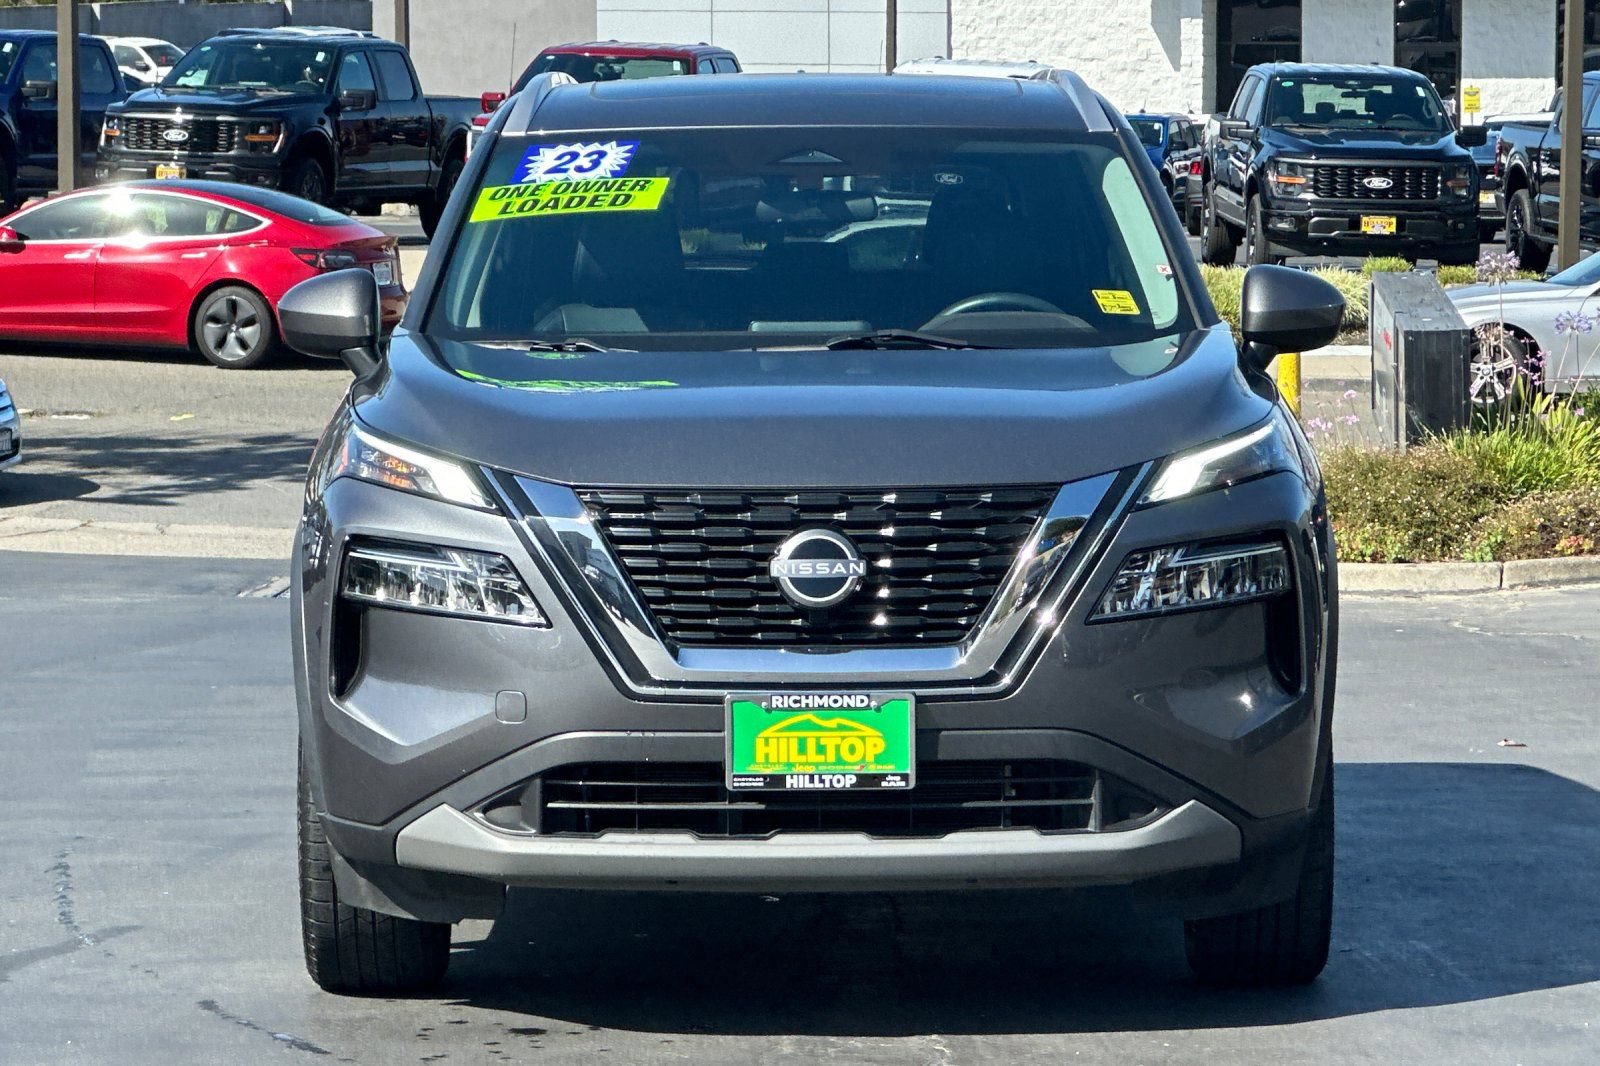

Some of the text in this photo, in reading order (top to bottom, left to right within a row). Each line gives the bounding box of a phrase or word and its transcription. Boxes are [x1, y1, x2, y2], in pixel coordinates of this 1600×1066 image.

[543, 150, 608, 174] 23
[489, 178, 653, 201] ONE OWNER
[498, 193, 634, 216] LOADED
[773, 562, 864, 575] NISSAN
[771, 695, 869, 708] RICHMOND
[755, 737, 886, 763] HILLTOP
[785, 774, 857, 789] HILLTOP
